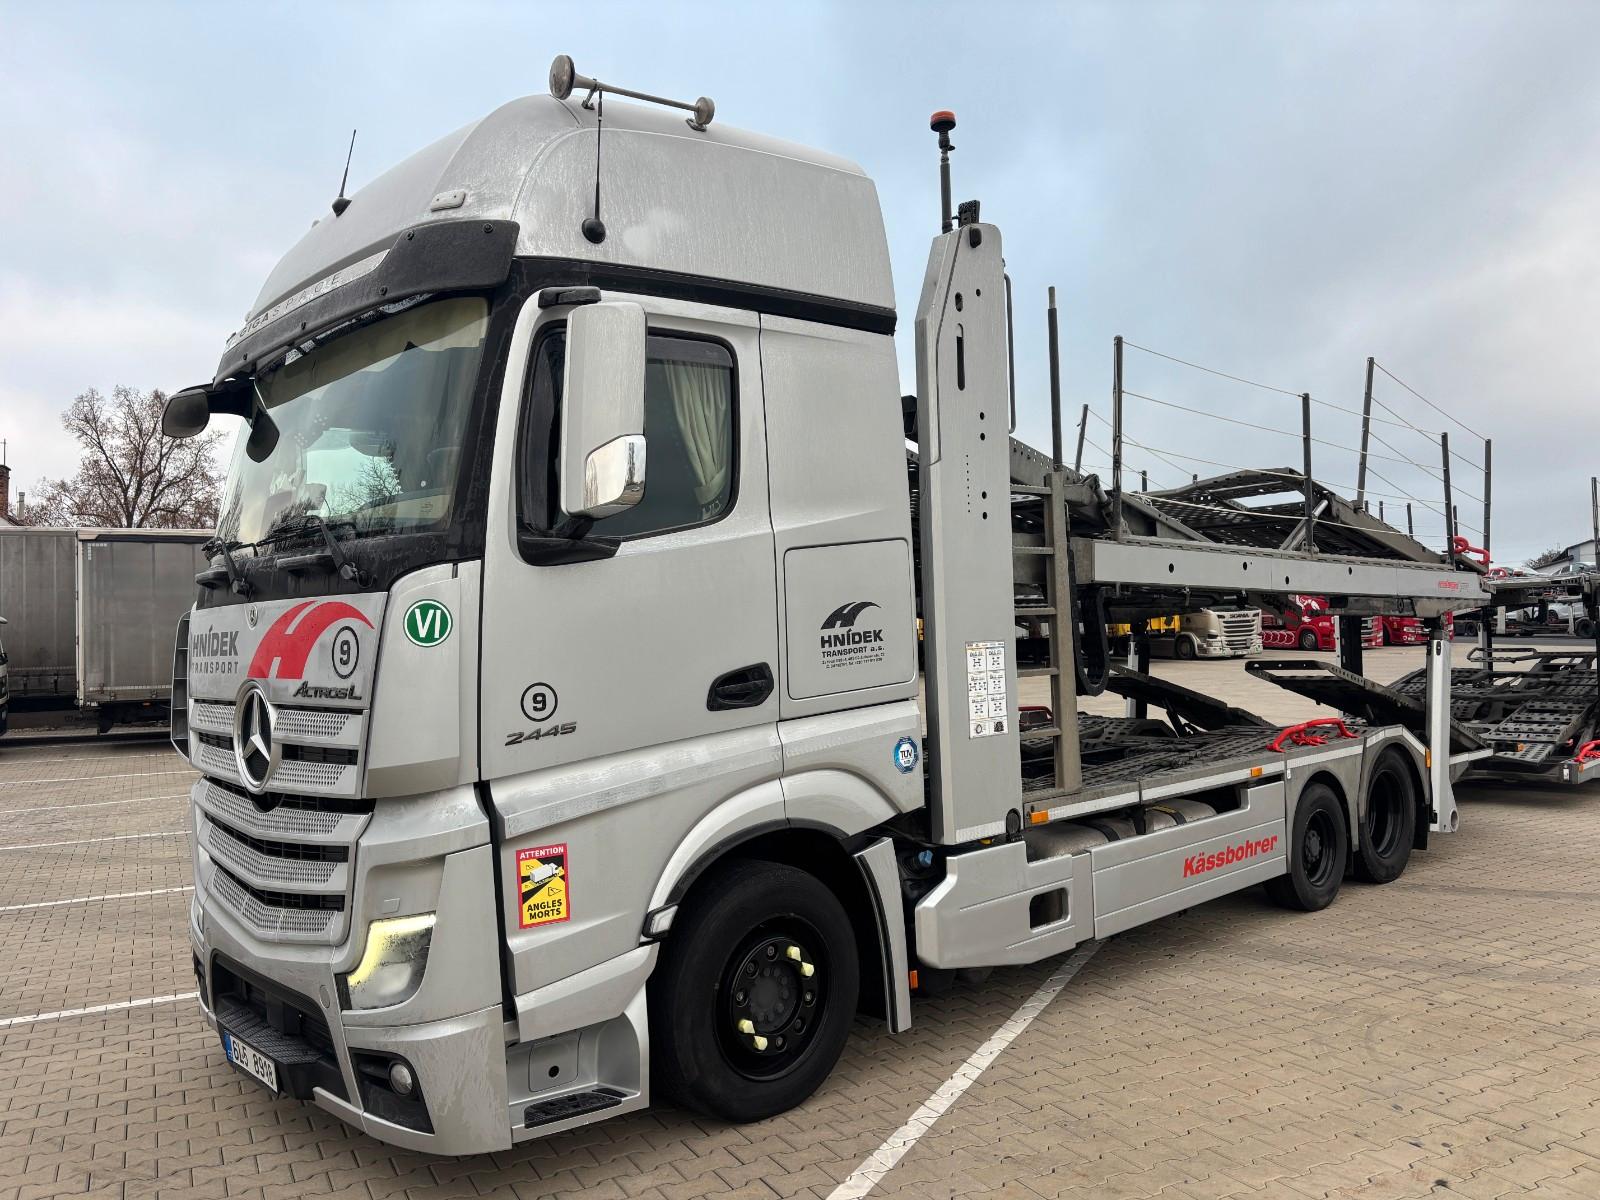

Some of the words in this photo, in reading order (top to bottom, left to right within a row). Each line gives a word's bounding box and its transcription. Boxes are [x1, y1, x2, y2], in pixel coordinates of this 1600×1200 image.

[414, 608, 442, 639] VI
[192, 623, 239, 657] HNÍDEK
[820, 628, 884, 648] HNÍDEK
[339, 640, 351, 666] 9
[822, 646, 868, 658] TRANSPORT
[191, 661, 239, 674] TRANSPORT
[532, 692, 547, 712] 9
[504, 721, 577, 746] 2445
[520, 846, 564, 860] ATTENTION
[1183, 835, 1278, 878] Kässbohrer
[527, 898, 562, 912] ANGLES
[529, 907, 562, 921] MORTS
